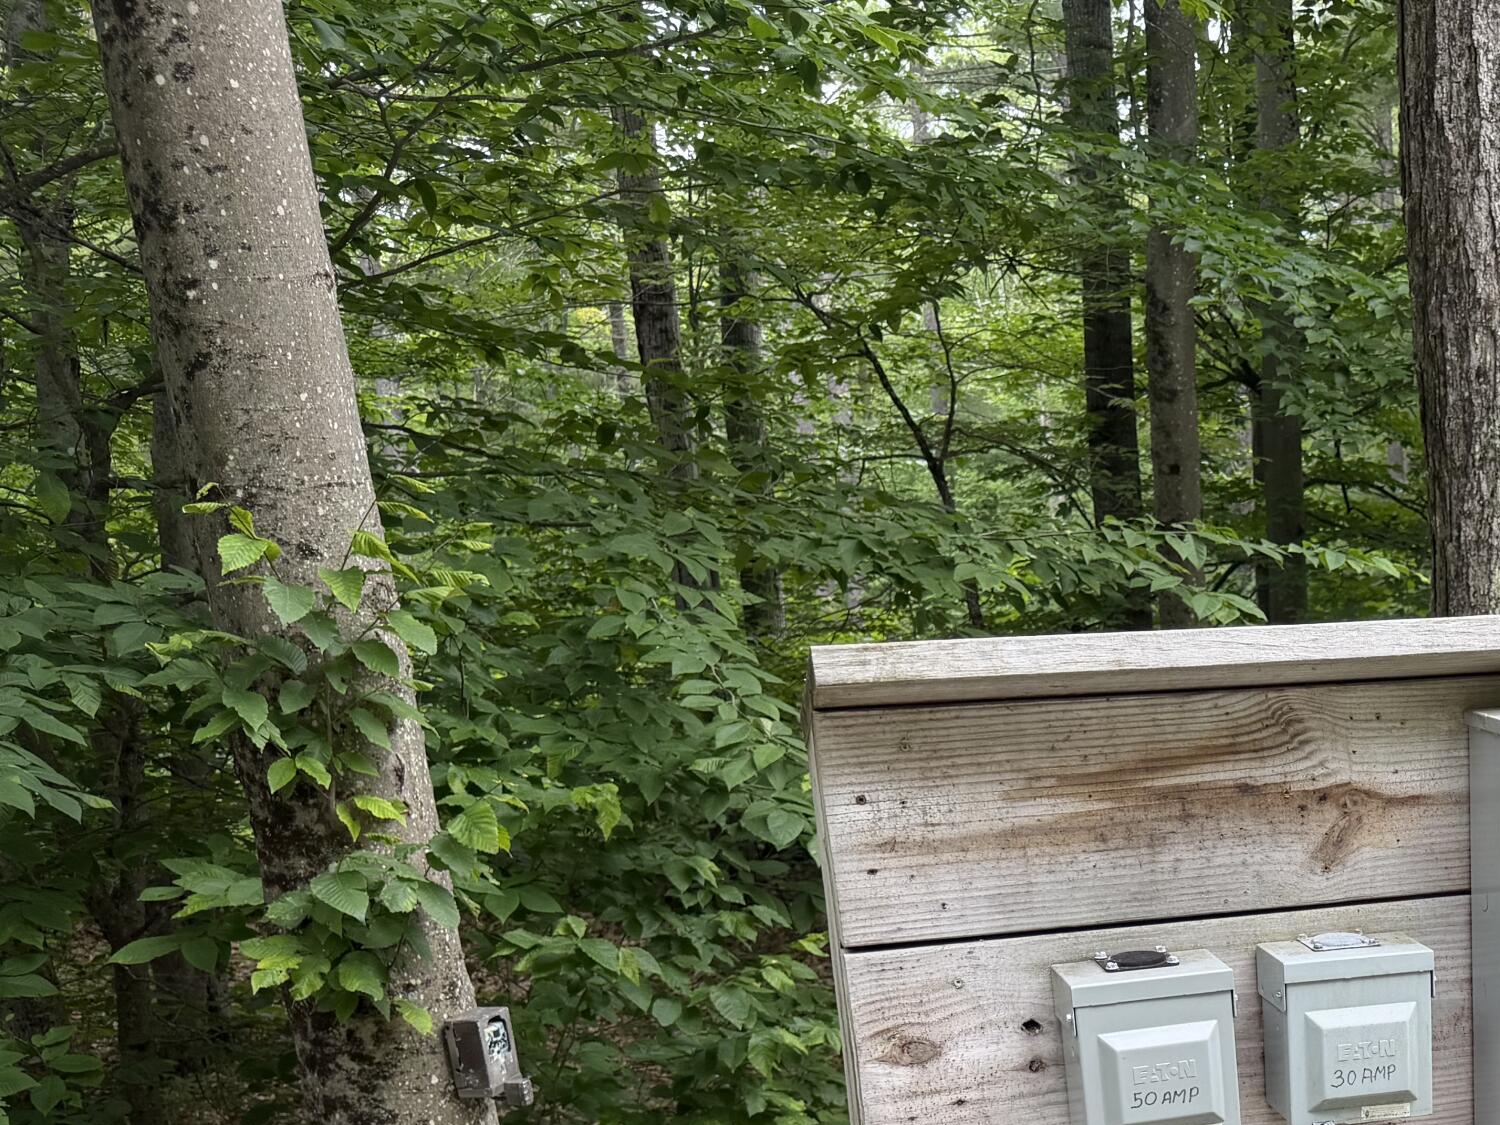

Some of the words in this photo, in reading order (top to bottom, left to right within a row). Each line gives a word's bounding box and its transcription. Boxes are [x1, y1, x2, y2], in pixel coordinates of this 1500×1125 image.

[1337, 1039, 1396, 1062] EATON
[1132, 1059, 1197, 1085] EATON
[1330, 1069, 1357, 1088] 30
[1361, 1064, 1396, 1085] AMP
[1130, 1091, 1158, 1109] 50
[1161, 1086, 1200, 1105] AMP
